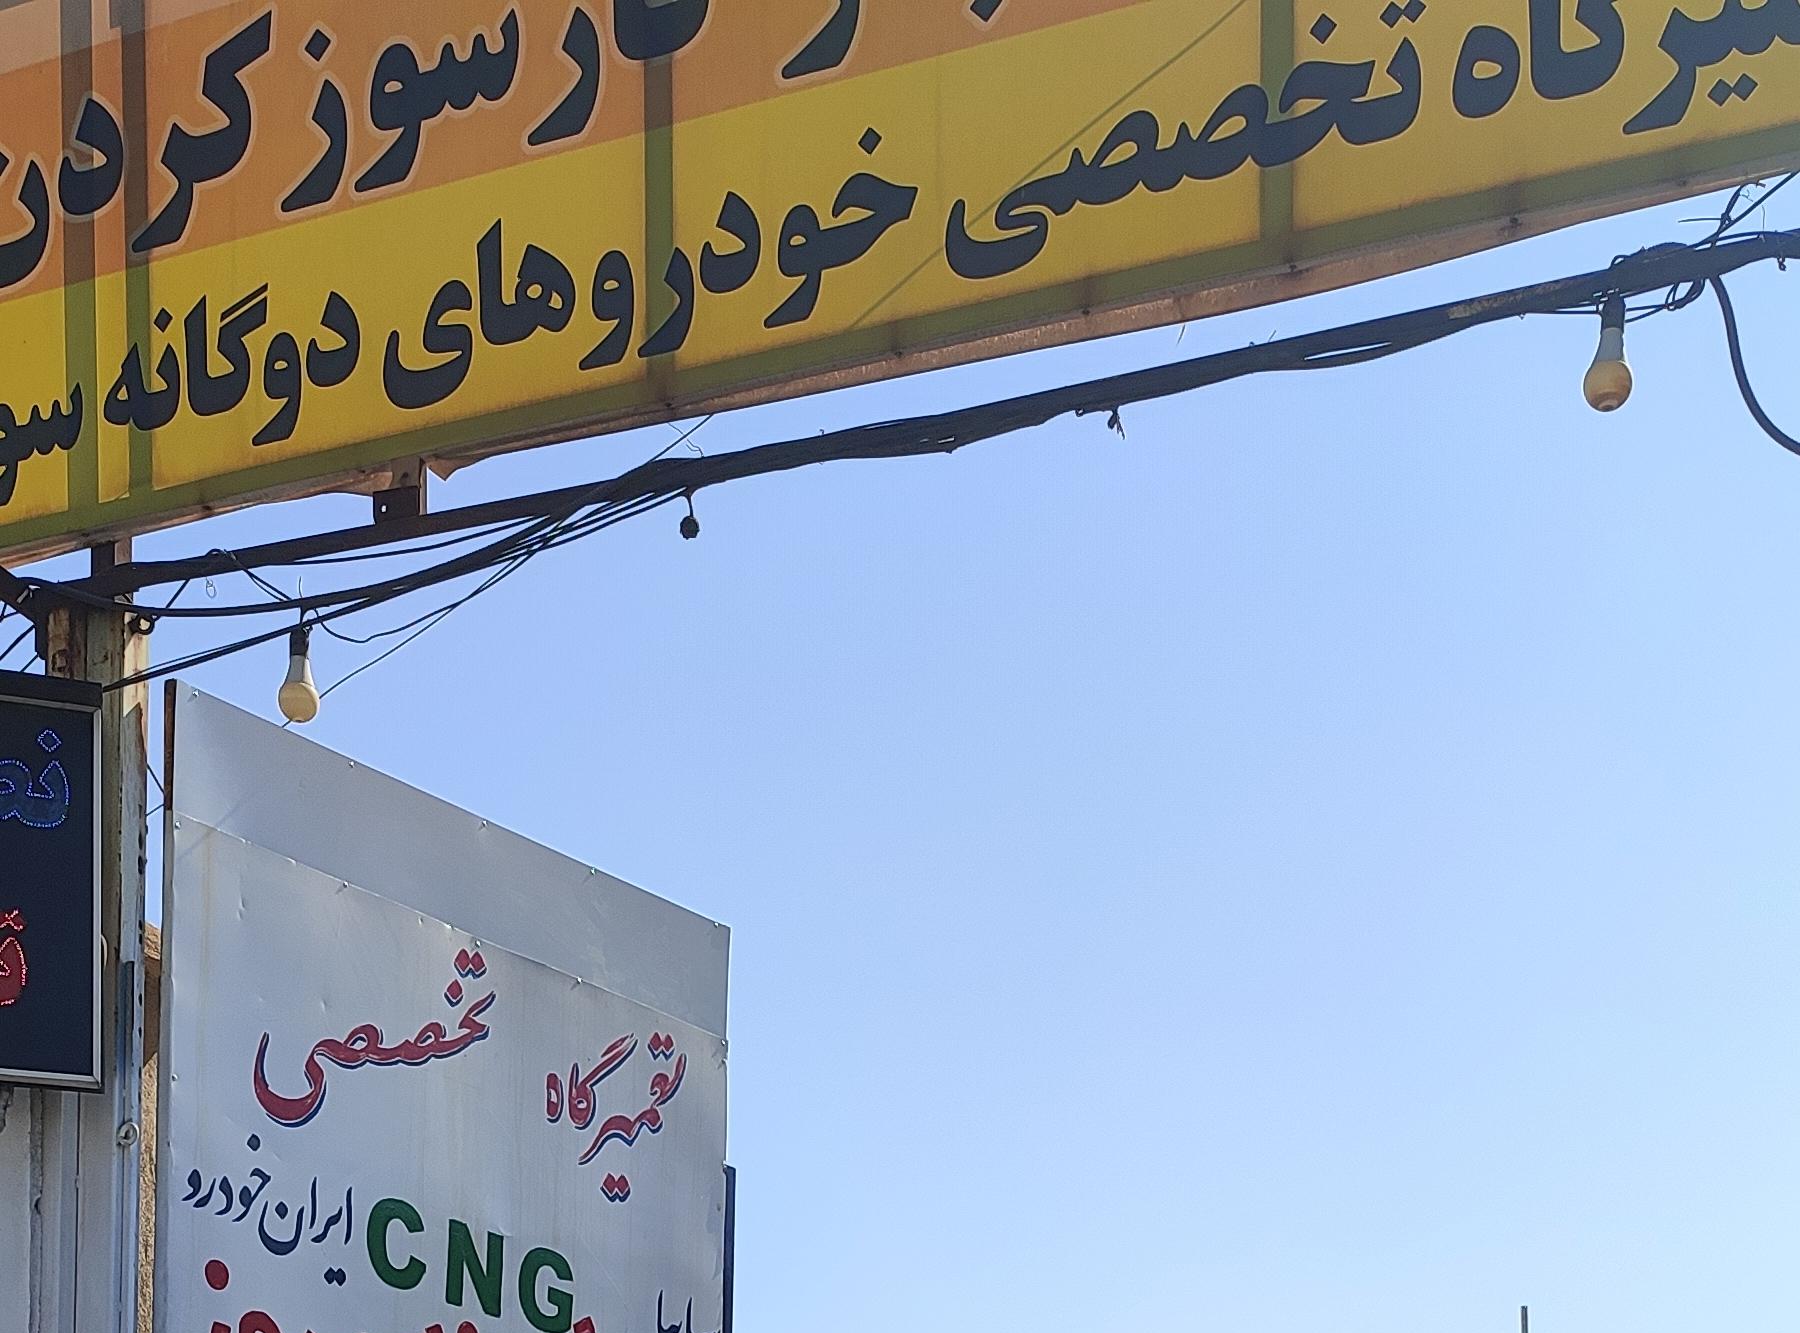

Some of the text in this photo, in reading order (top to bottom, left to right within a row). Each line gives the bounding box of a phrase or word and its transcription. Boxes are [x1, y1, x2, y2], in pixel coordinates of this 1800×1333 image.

[945, 0, 1425, 280] تخصصی
[103, 283, 361, 447] دوگانه
[253, 948, 690, 1204] تعمیرگاه تخصصی
[181, 1133, 354, 1287] ایران خودرو
